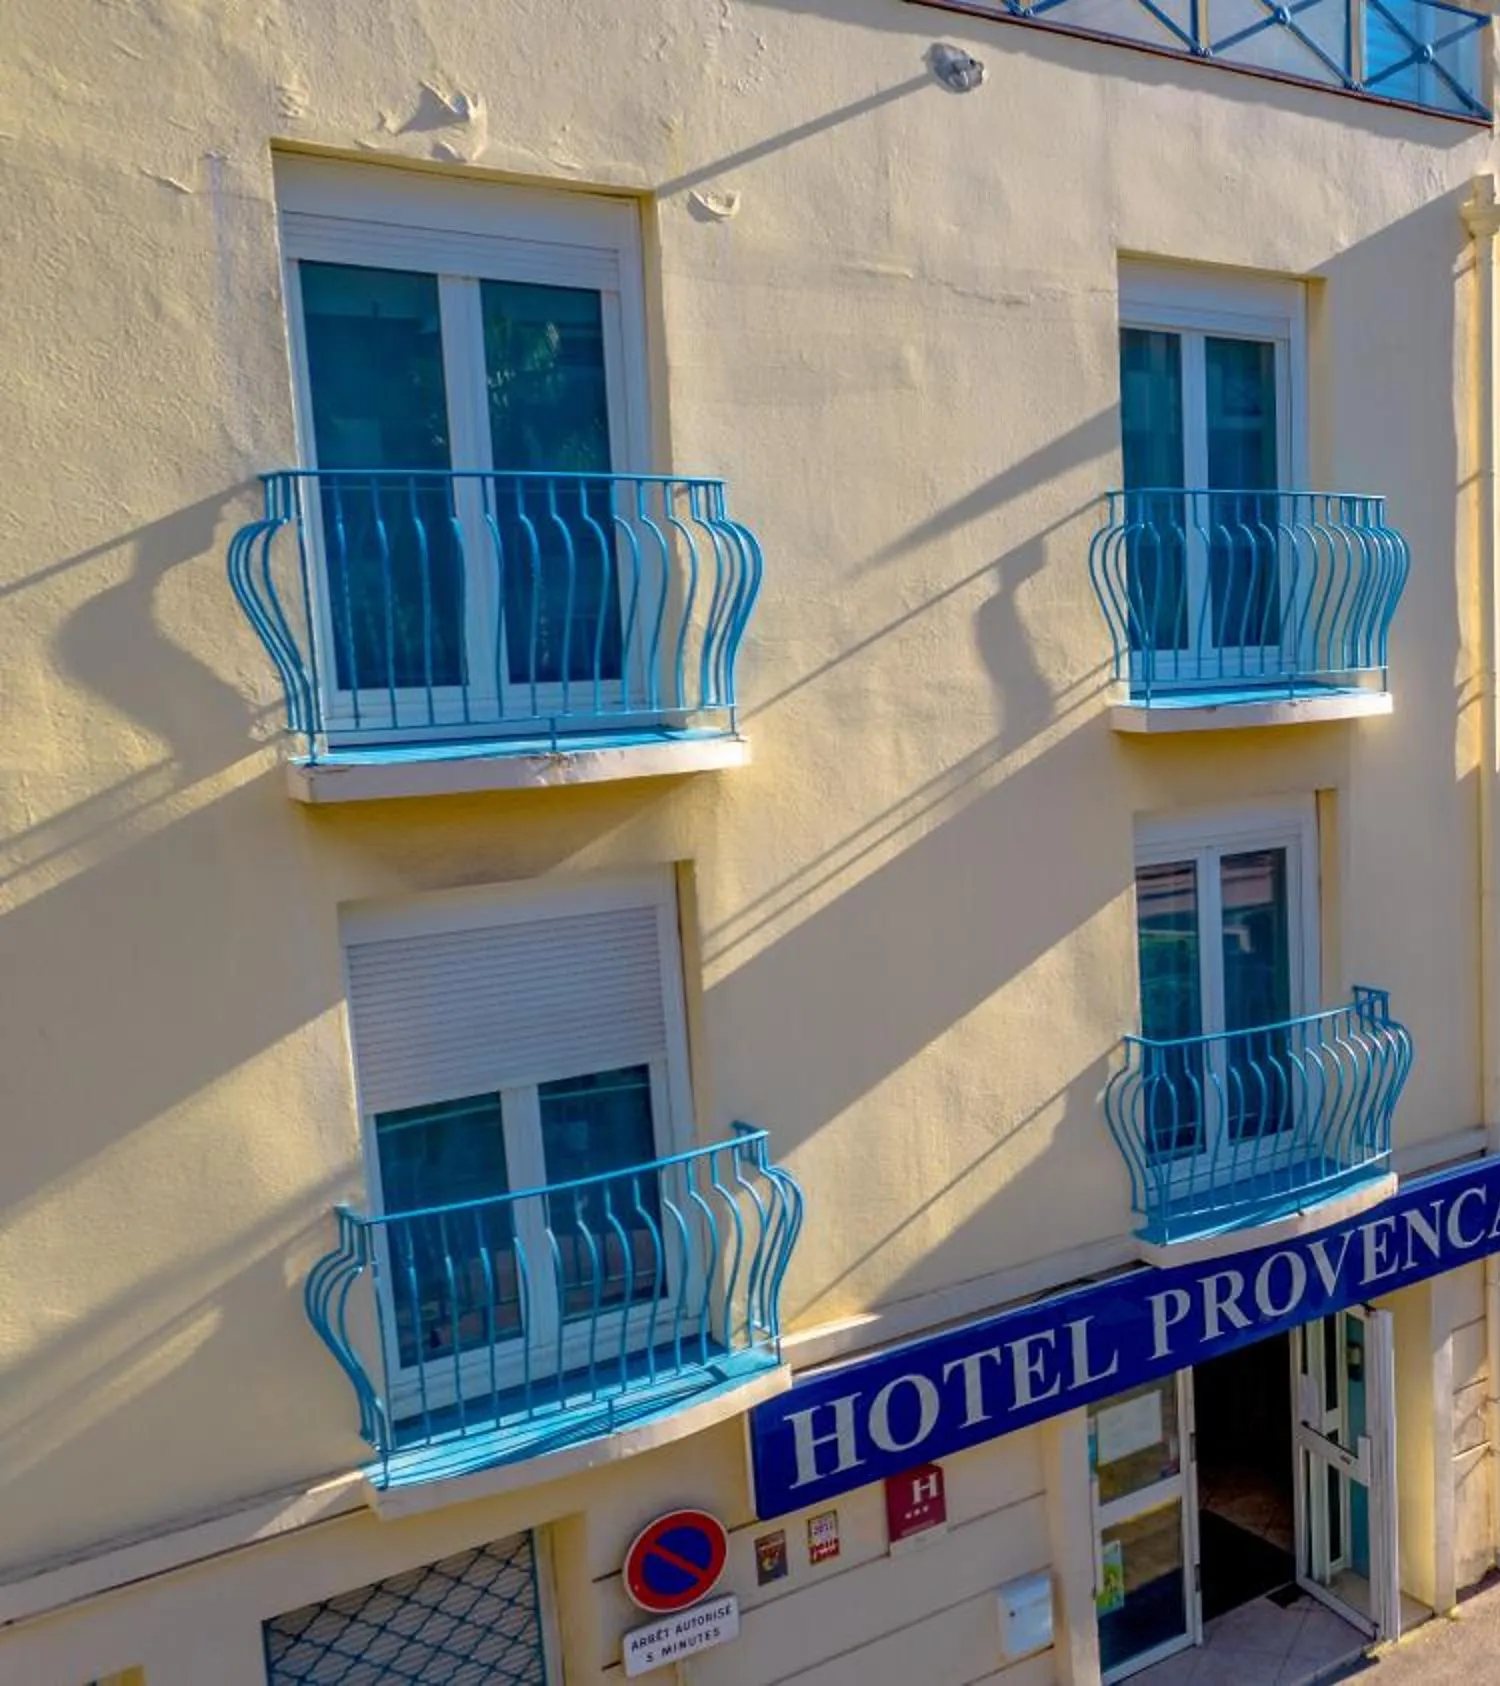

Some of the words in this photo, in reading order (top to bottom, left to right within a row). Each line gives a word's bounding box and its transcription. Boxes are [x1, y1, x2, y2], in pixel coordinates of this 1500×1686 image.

[783, 1315, 1119, 1490] HOTEL
[912, 1472, 938, 1505] H
[631, 1627, 669, 1653] ARRÊT
[645, 1651, 654, 1663] 5
[661, 1627, 721, 1657] MINUTES
